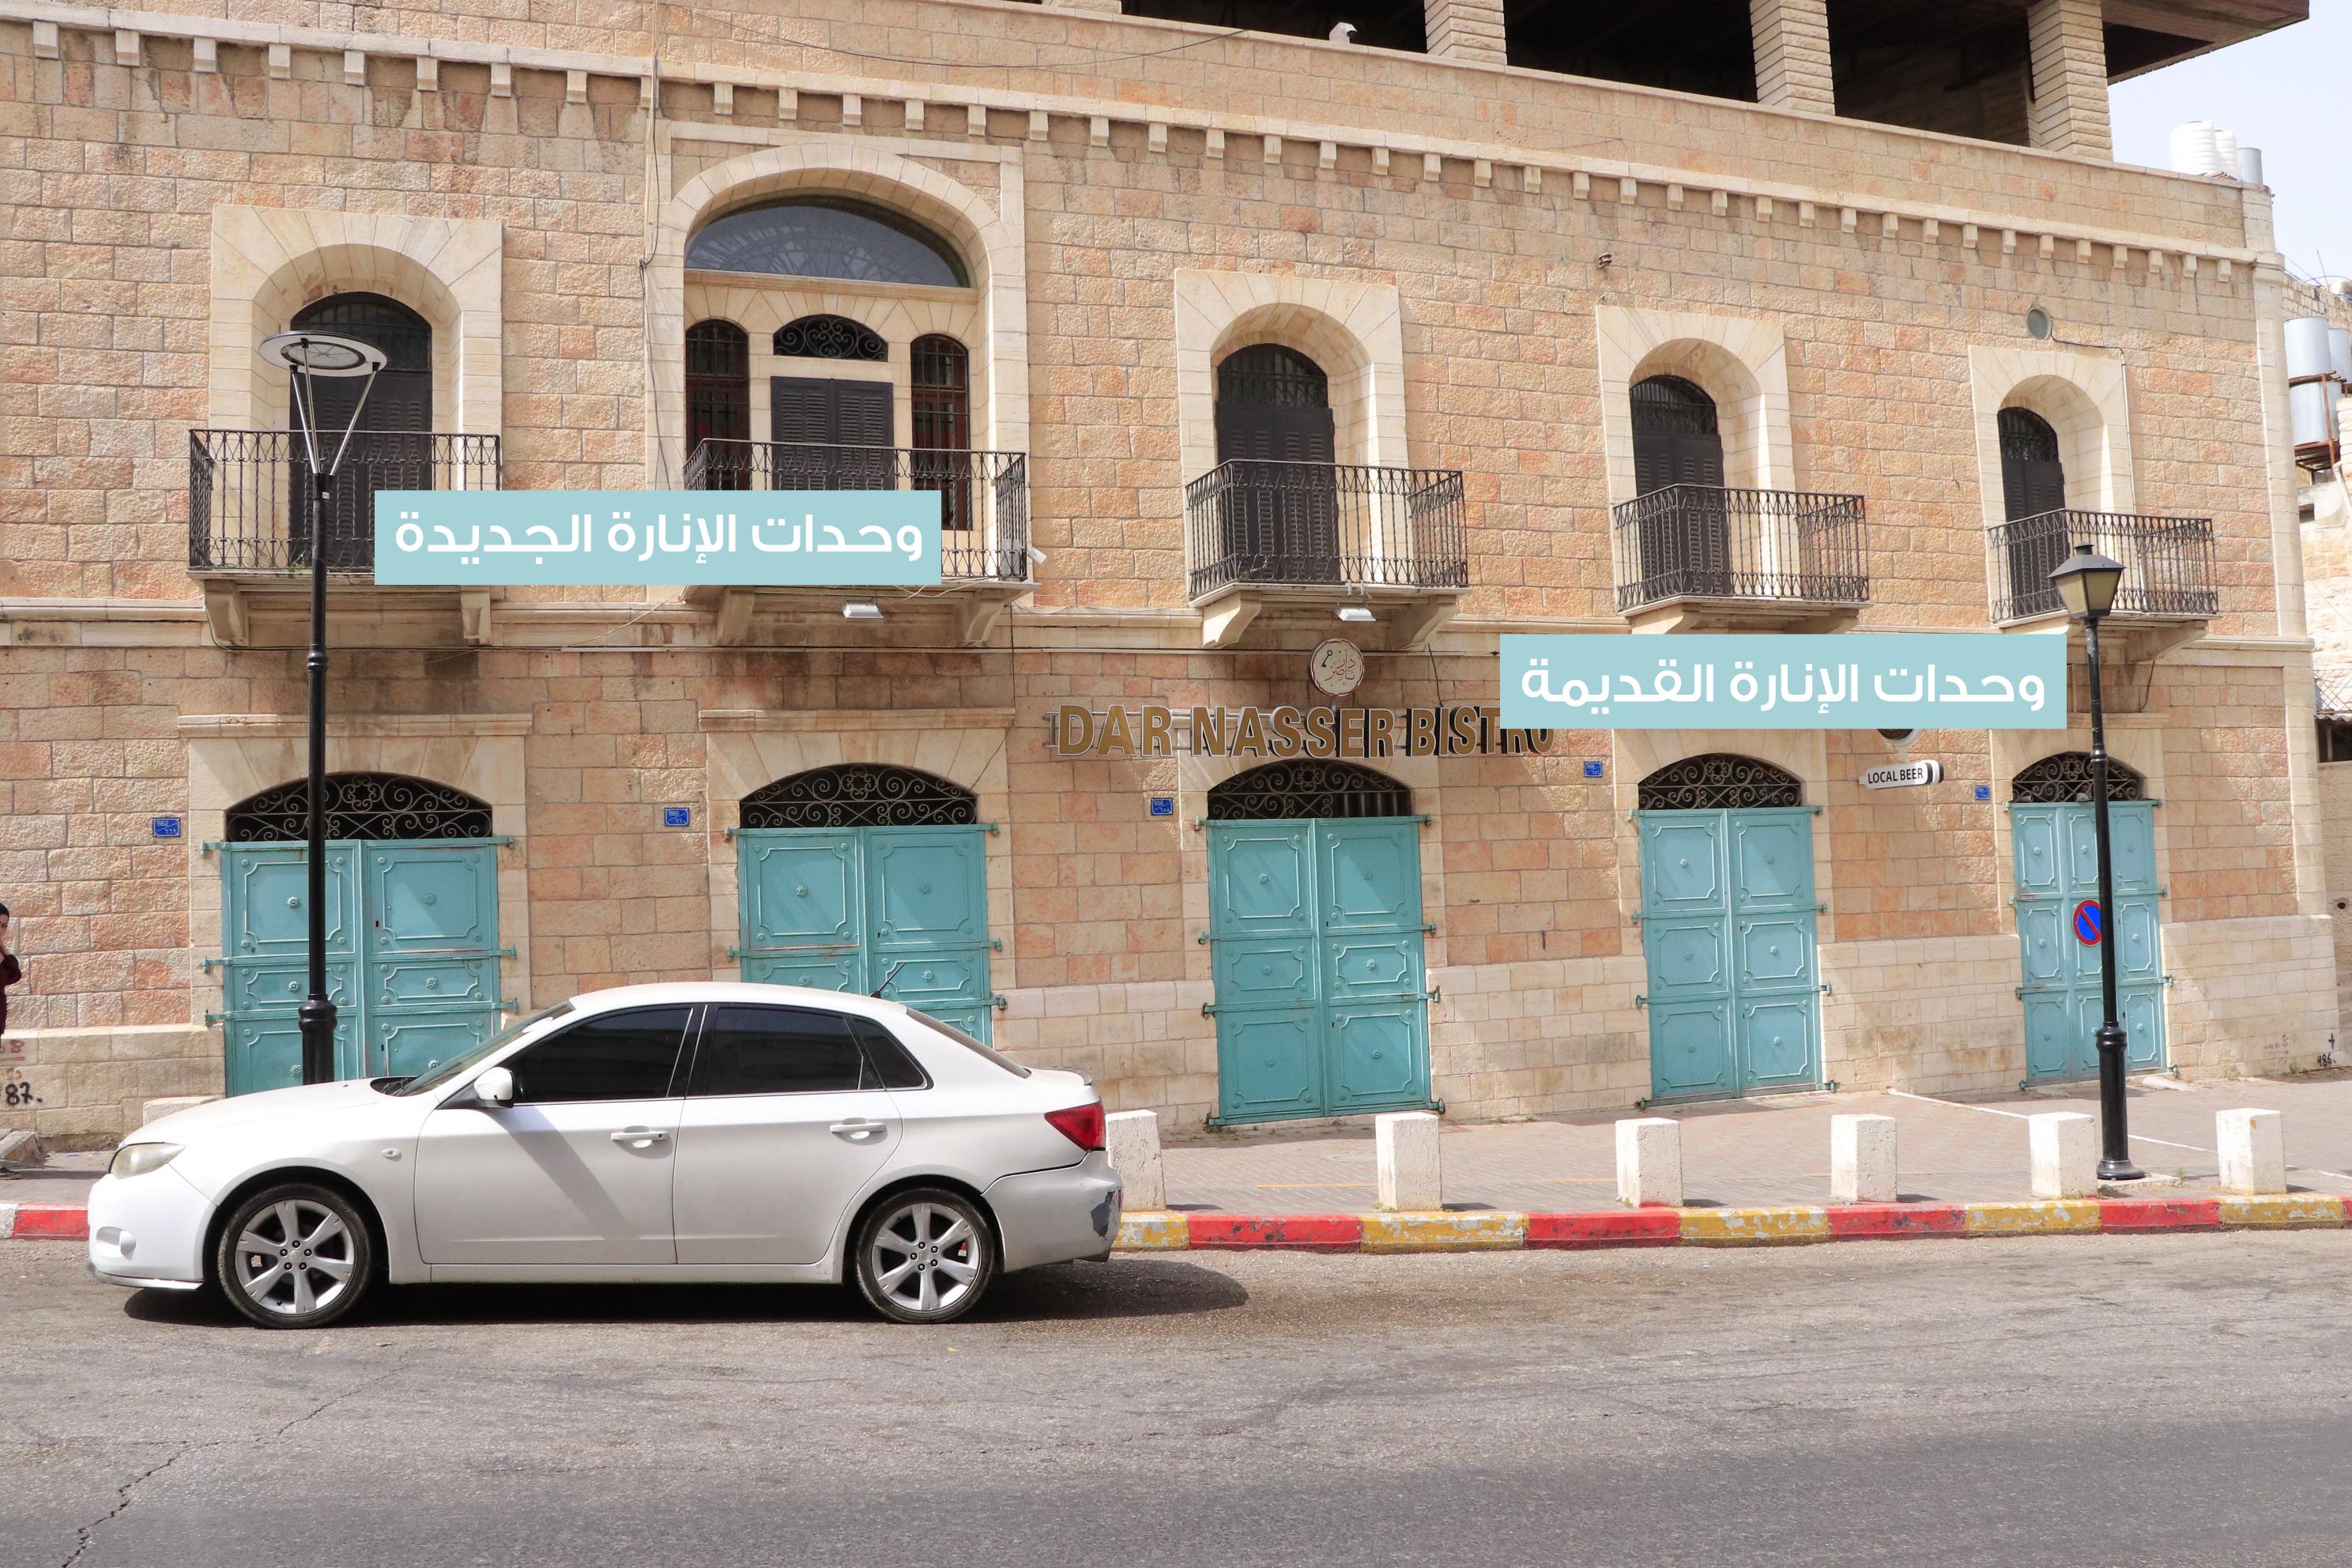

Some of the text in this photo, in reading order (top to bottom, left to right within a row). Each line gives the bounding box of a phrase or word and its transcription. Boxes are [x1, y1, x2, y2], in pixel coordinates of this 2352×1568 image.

[1057, 704, 1174, 756] DAR
[1190, 705, 1396, 759] NASSER
[1868, 767, 1924, 784] LOCAL BEER
